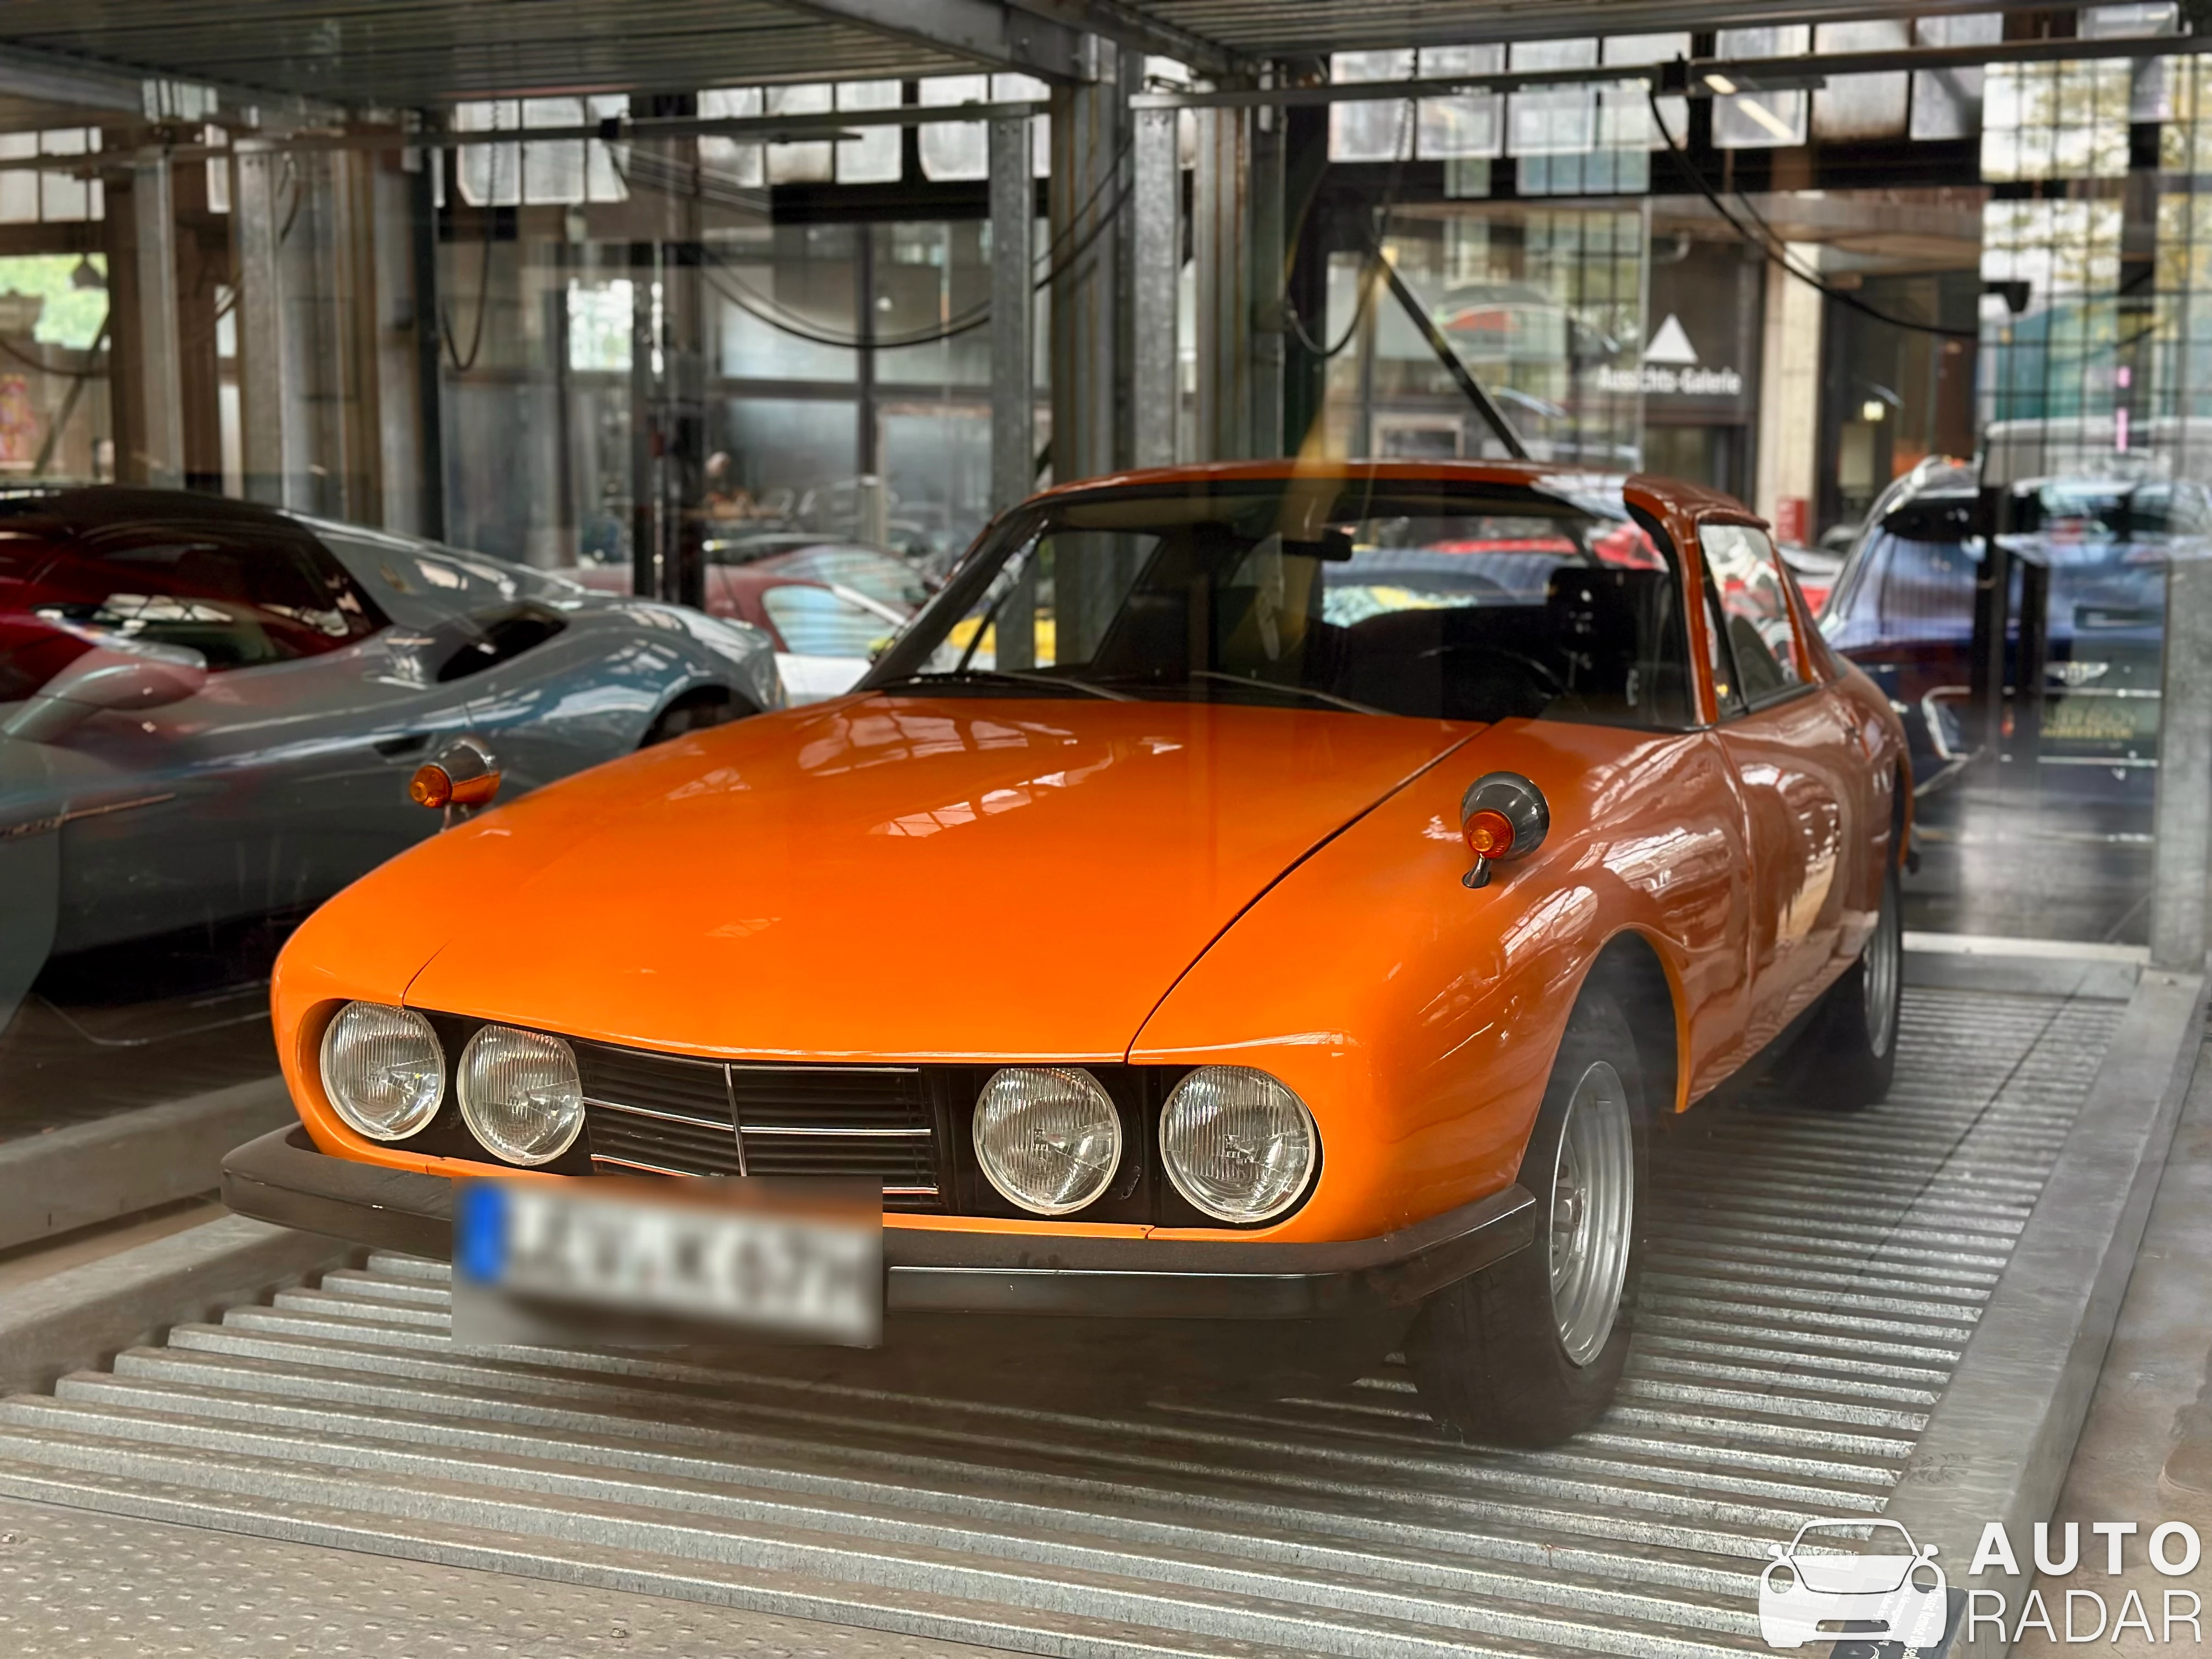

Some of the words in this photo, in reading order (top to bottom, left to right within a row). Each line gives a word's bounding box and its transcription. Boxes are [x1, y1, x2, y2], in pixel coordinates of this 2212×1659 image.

[1922, 1589, 1944, 1611] Classic
[1912, 1612, 1936, 1635] Remise
[1901, 1635, 1927, 1659] Düssel
